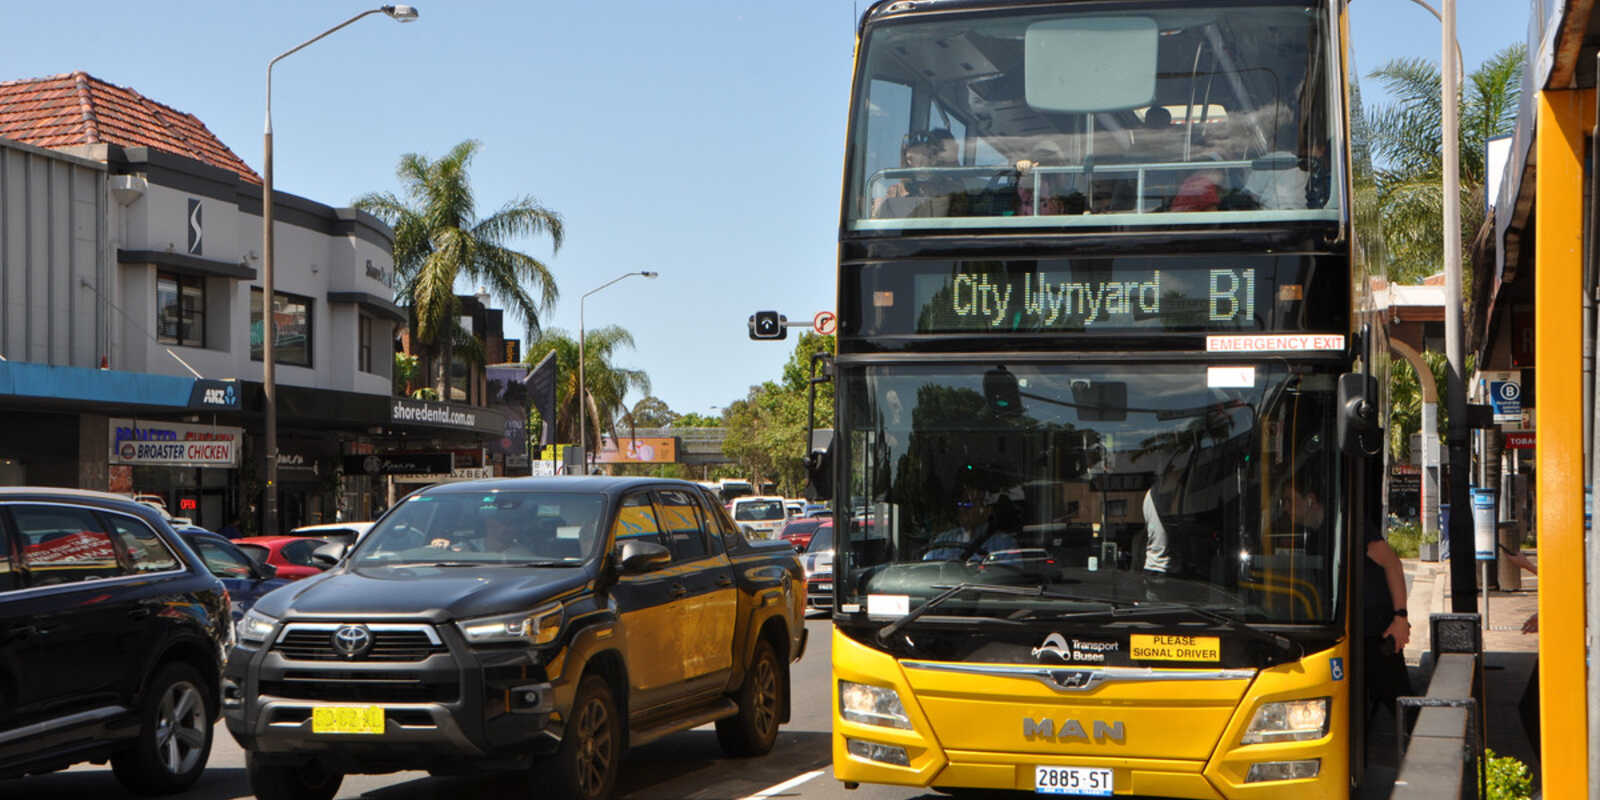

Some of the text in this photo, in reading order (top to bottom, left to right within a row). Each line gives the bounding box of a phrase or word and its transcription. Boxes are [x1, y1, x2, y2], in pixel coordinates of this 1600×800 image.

[952, 268, 1255, 326] City Wynyard B1
[1209, 337, 1343, 350] EMERGENCY EXIT
[203, 389, 225, 404] ANZ
[393, 400, 476, 426] shoredental.com.au
[1511, 437, 1536, 445] TOBA
[137, 444, 229, 460] BROASTER CHICKEN
[180, 499, 196, 510] OPEN
[1072, 639, 1120, 651] Transport
[1153, 636, 1196, 646] PLEASE
[1072, 651, 1105, 661] Buses
[1133, 647, 1217, 658] SIGNAL DRIVER
[1023, 717, 1126, 743] MAN
[1039, 769, 1110, 788] 2885 ST
